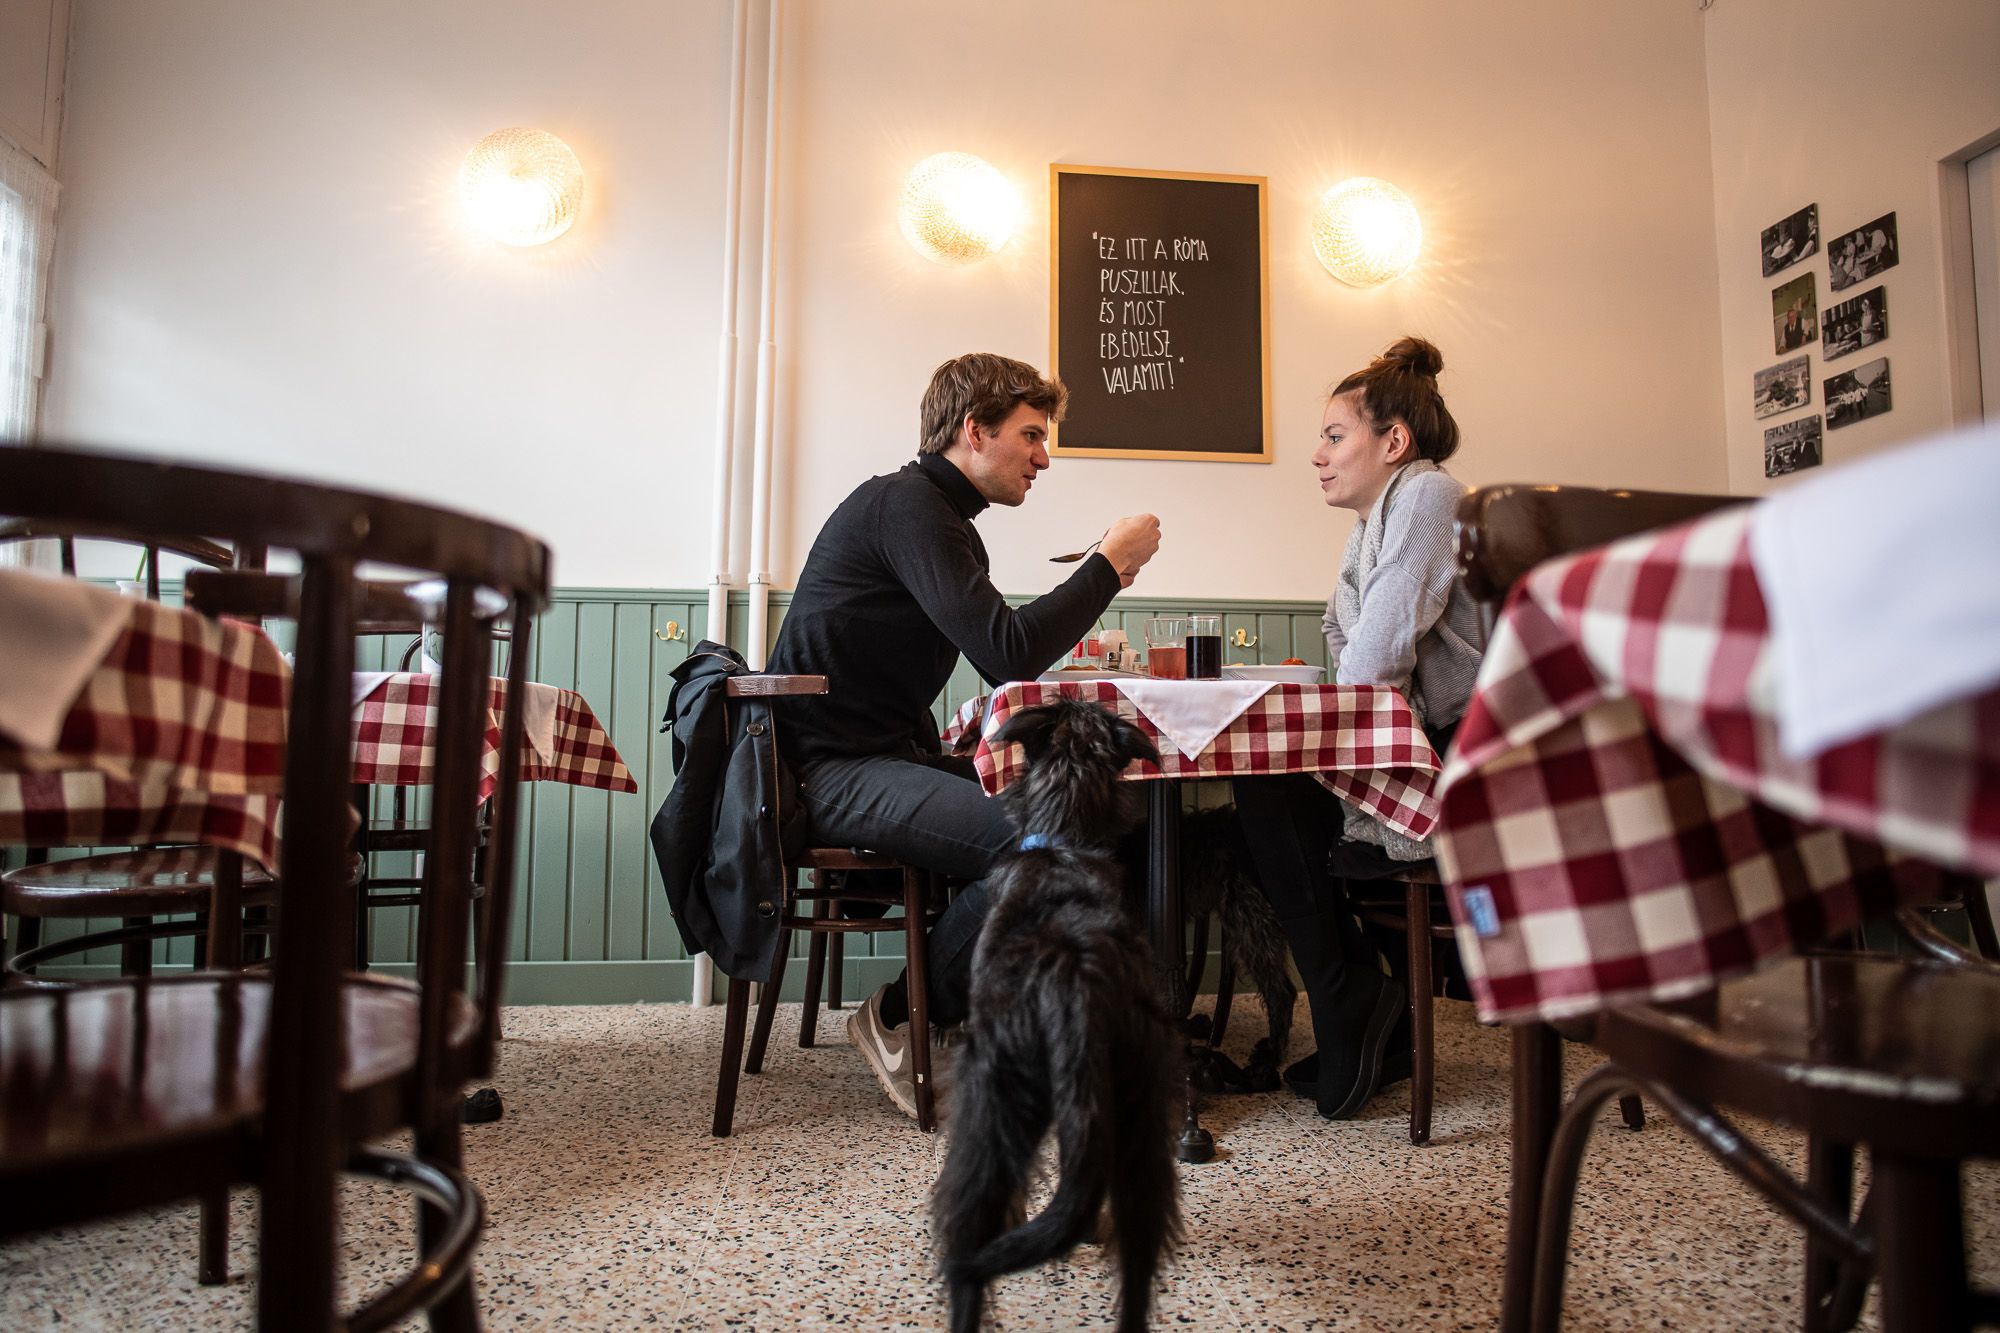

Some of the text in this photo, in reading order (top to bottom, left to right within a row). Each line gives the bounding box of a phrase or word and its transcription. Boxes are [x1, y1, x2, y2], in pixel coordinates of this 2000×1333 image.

[1126, 238, 1148, 261] ITT
[1154, 239, 1168, 260] A
[1173, 236, 1209, 262] RÓMA
[1100, 268, 1185, 296] PUSZILLAK.
[1099, 297, 1167, 327] ÉS MOST
